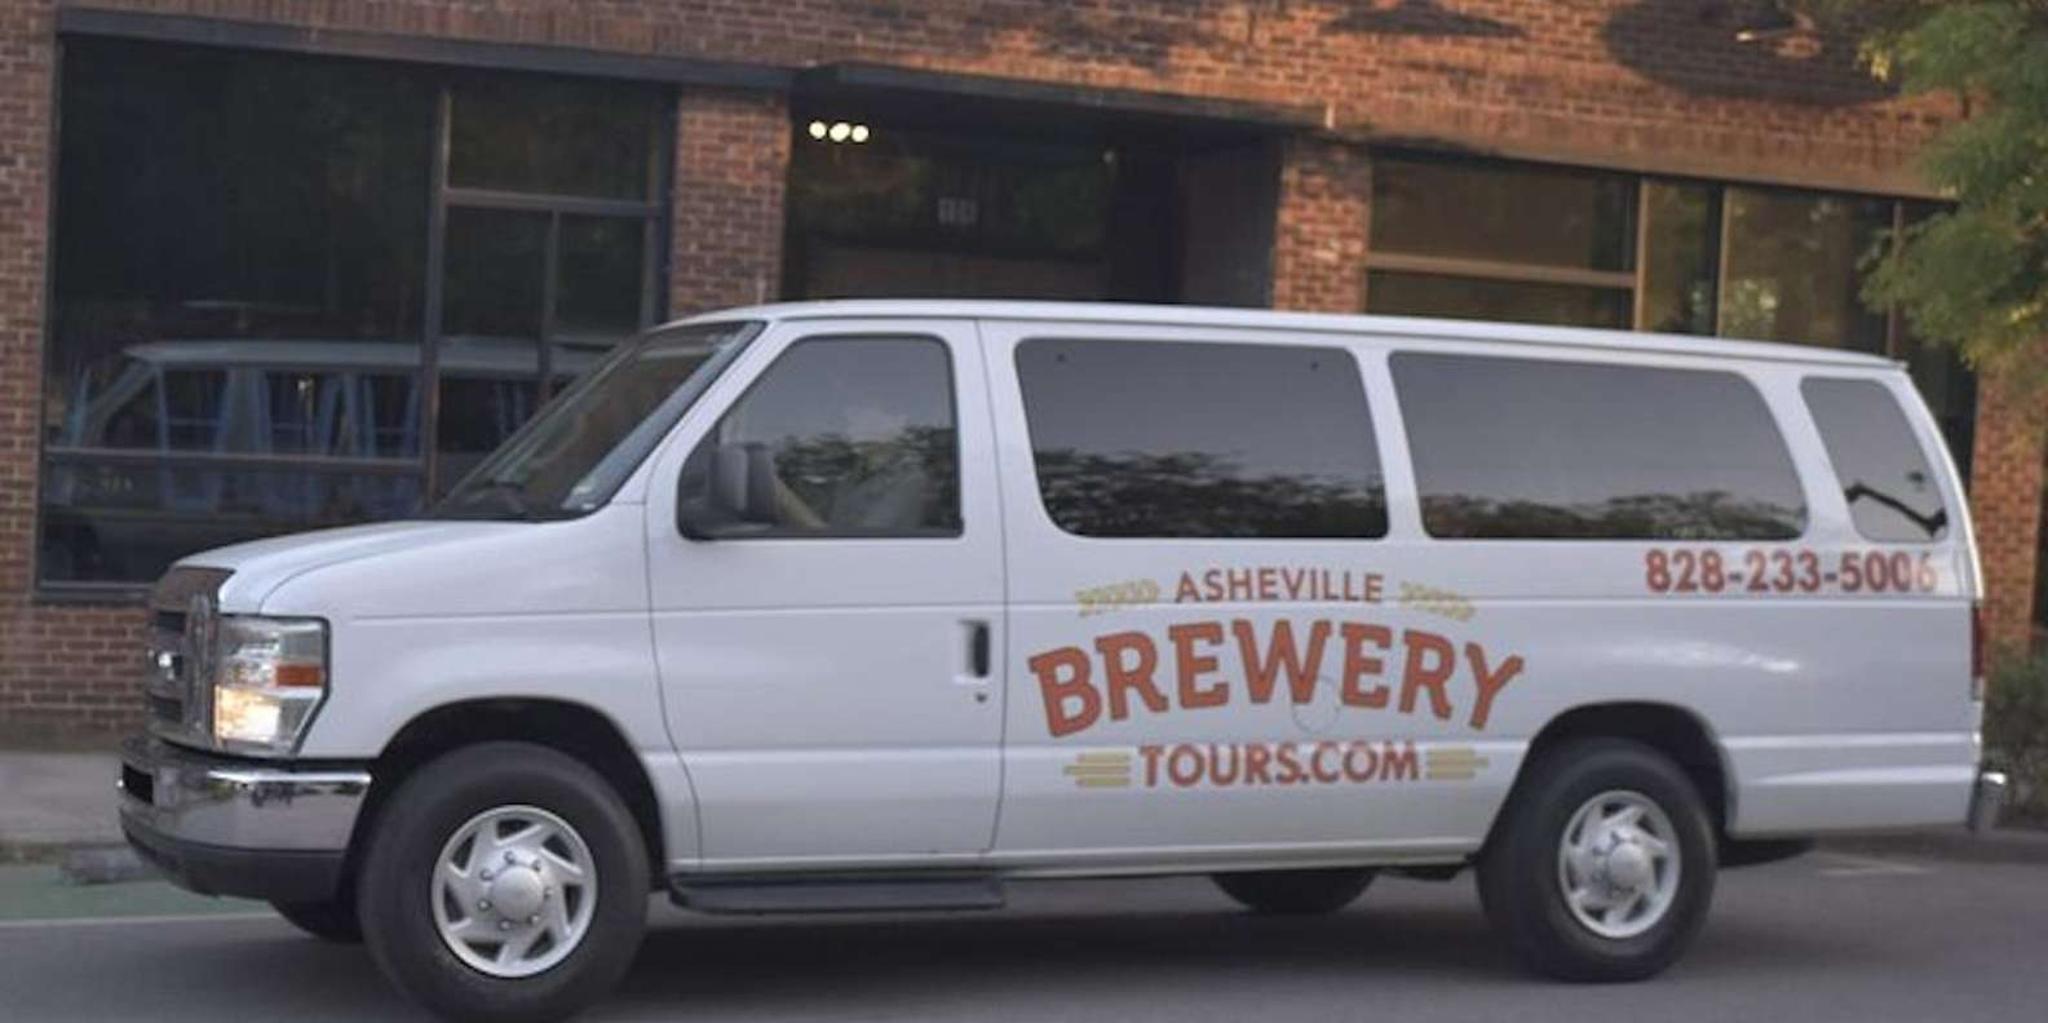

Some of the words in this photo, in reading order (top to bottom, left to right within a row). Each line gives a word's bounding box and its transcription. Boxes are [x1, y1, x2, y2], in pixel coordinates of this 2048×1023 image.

[1174, 569, 1384, 603] ASHEVILLE
[1645, 549, 1937, 592] 828-233-5006
[1028, 618, 1524, 738] BREWERY
[1139, 742, 1419, 788] TOURS.COM
